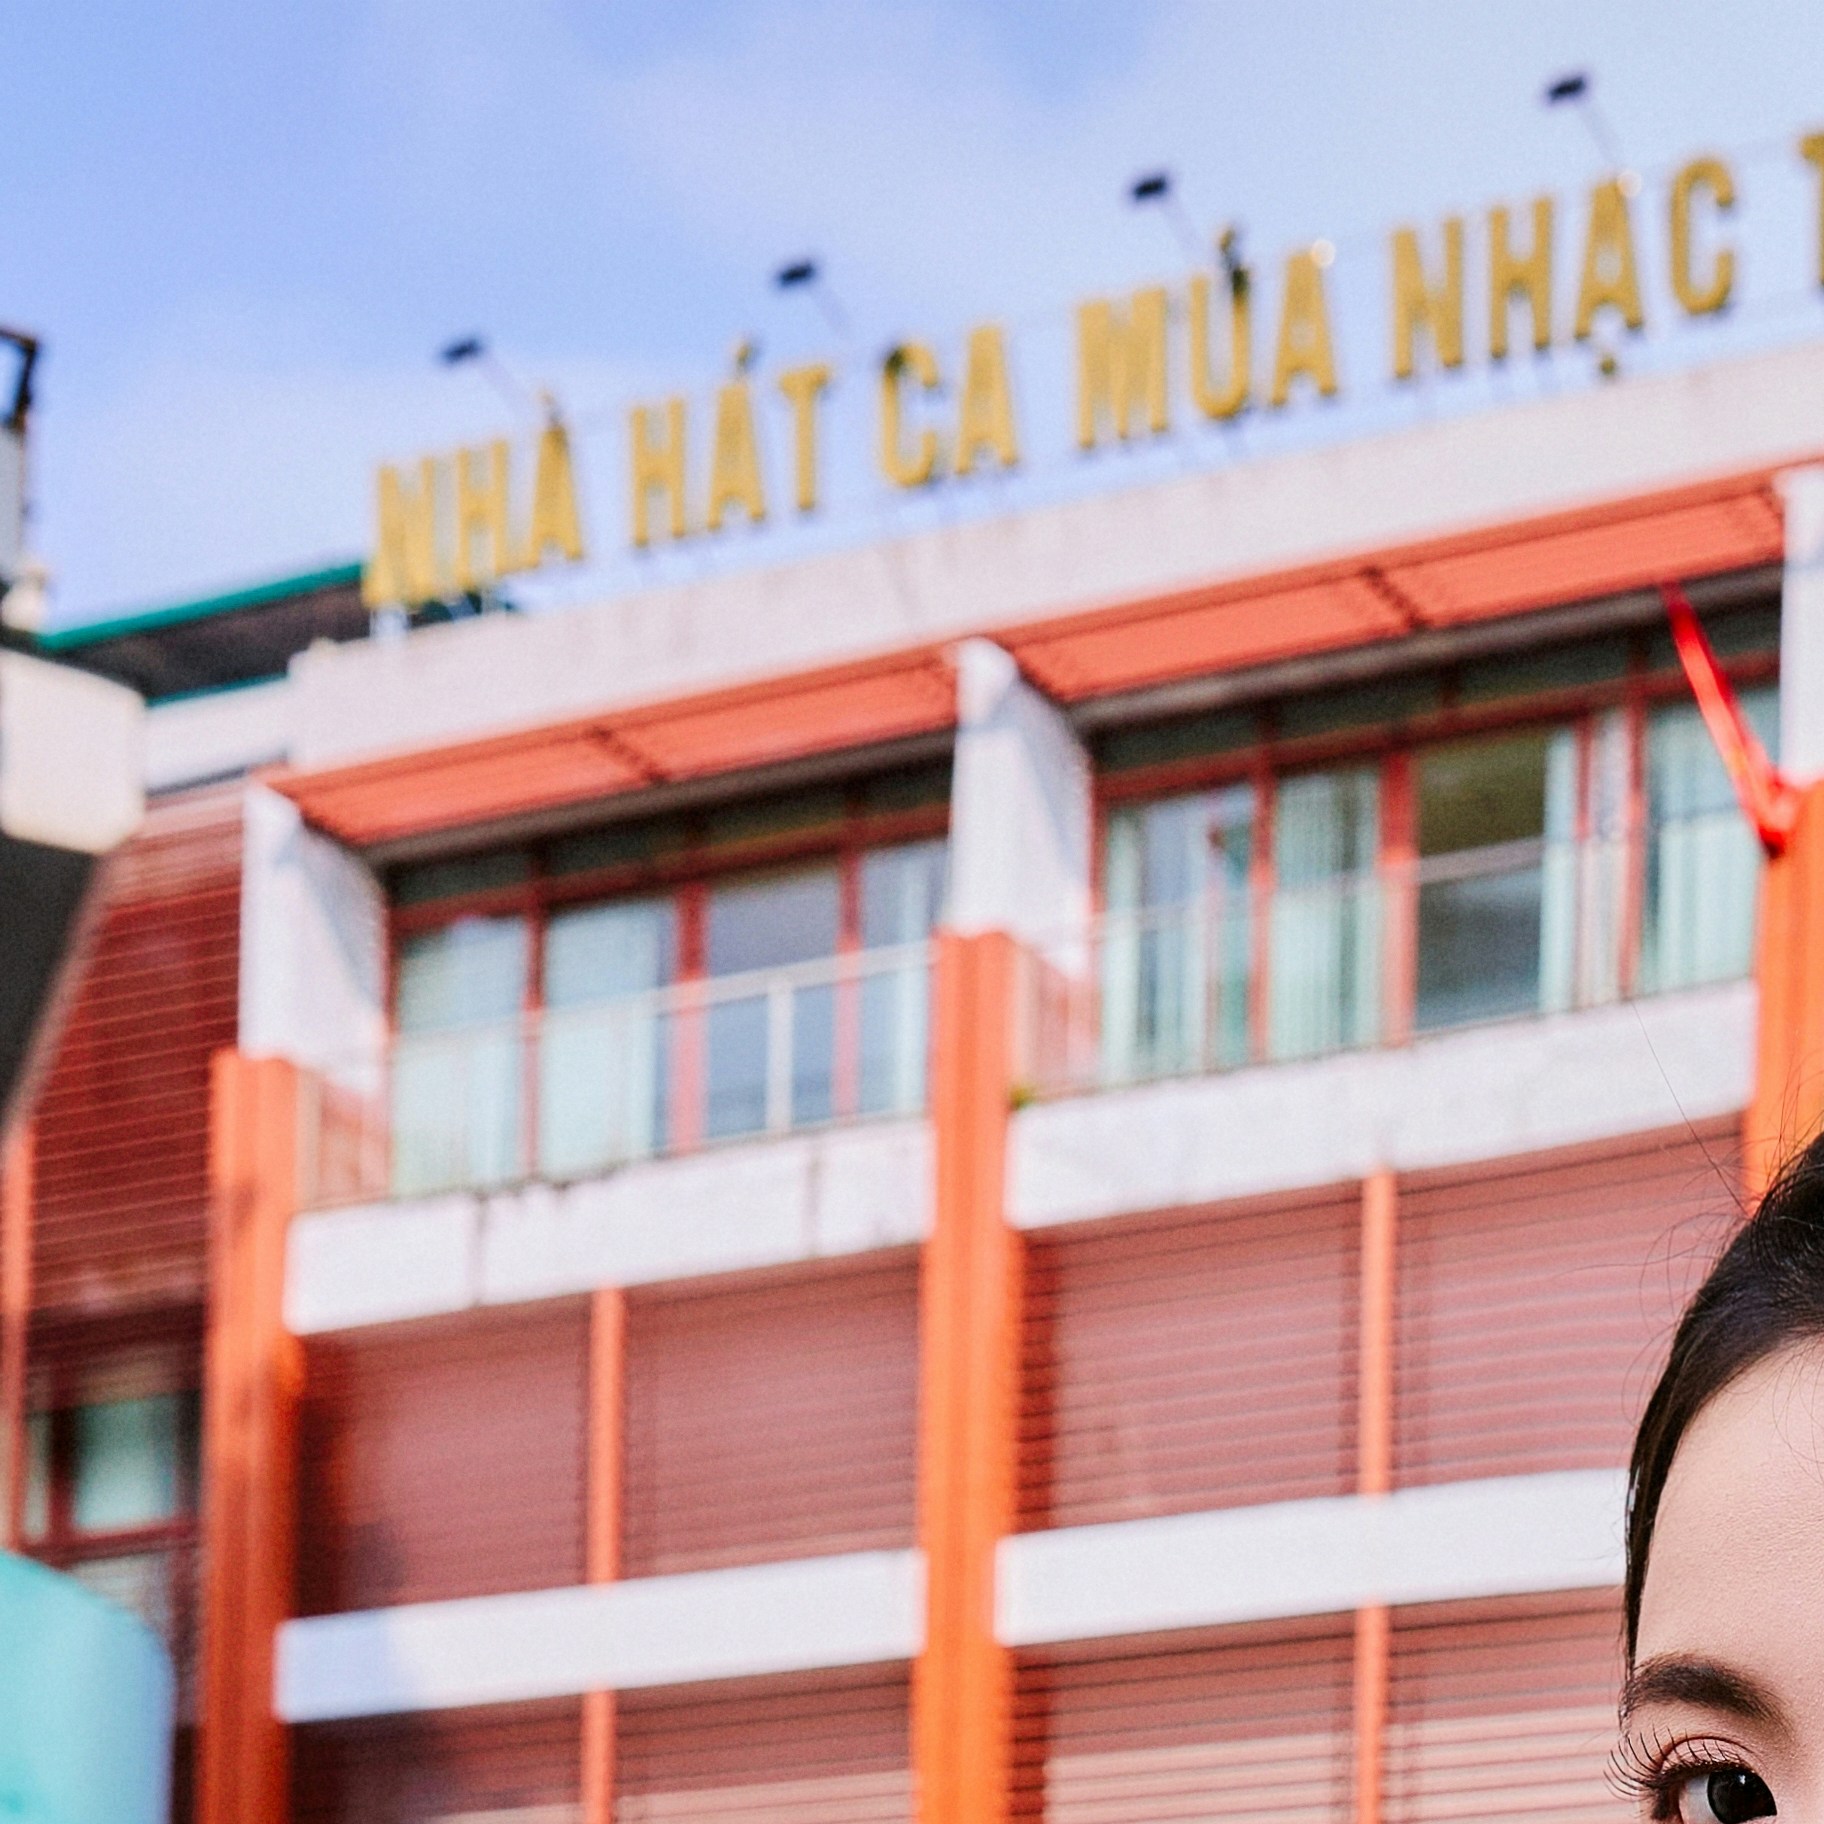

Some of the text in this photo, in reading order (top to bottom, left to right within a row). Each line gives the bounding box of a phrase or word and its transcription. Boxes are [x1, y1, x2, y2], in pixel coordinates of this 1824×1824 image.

[364, 386, 583, 607] NHÀ
[630, 338, 832, 549] HÁT
[880, 322, 1020, 487] CA
[1078, 228, 1338, 446] MÚA
[1390, 157, 1736, 379] NHẠC
